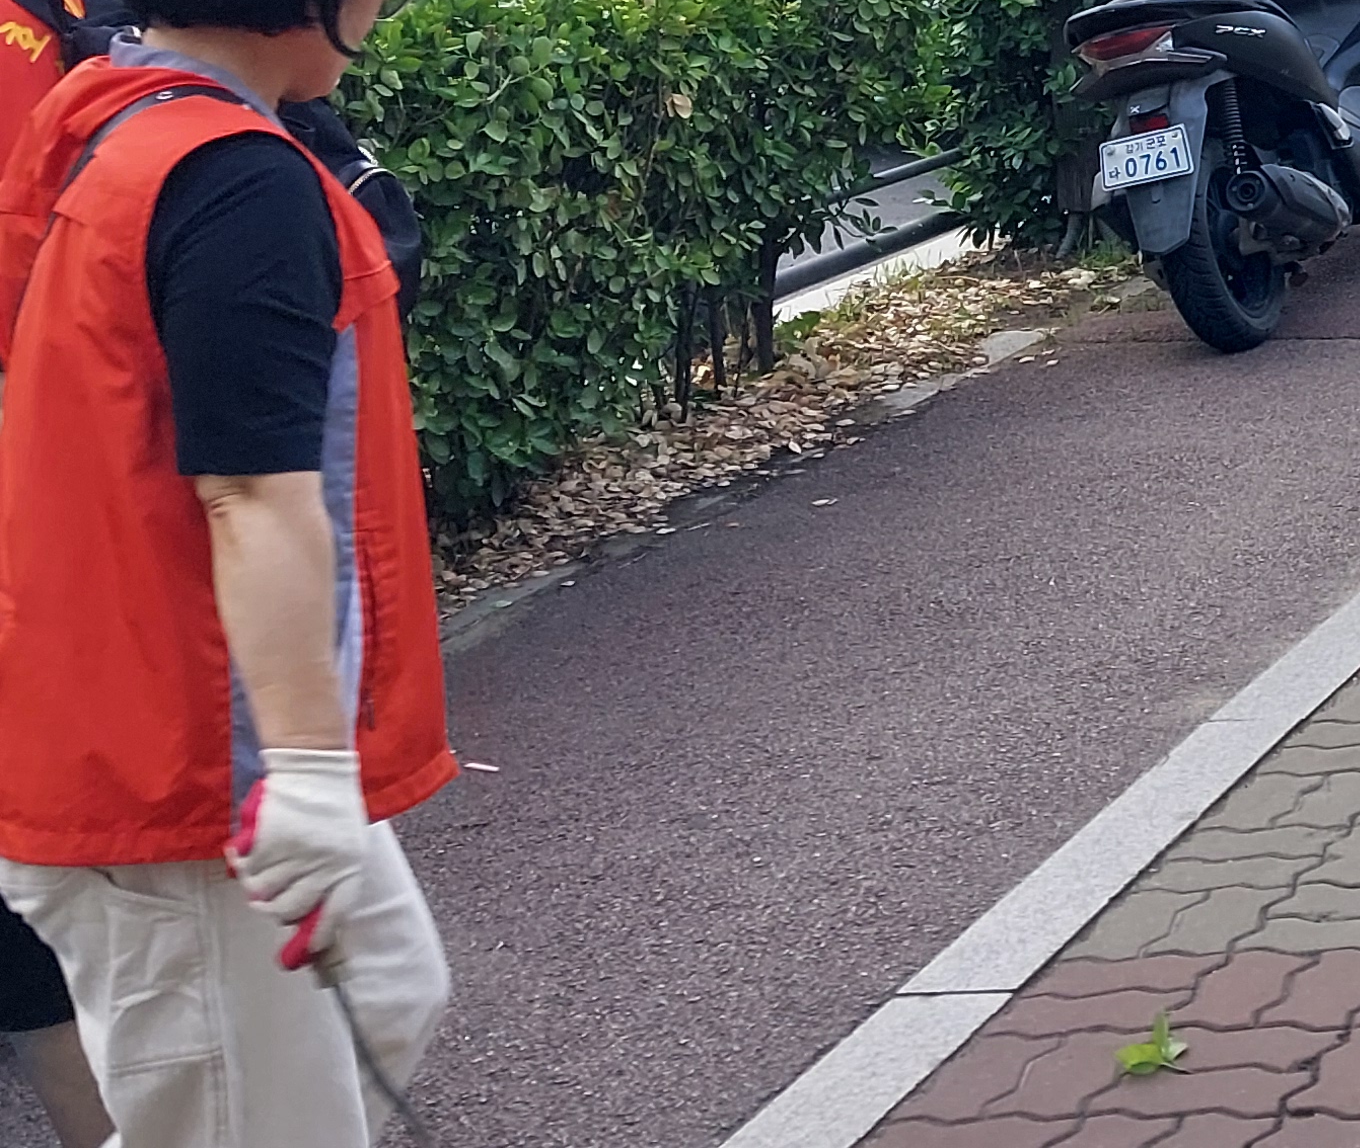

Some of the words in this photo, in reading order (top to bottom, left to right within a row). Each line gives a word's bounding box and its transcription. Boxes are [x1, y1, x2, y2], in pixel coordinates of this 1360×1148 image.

[1215, 24, 1266, 39] PCX
[1146, 135, 1167, 150] 군포
[1108, 166, 1121, 180] 다
[1125, 146, 1181, 178] 0761
